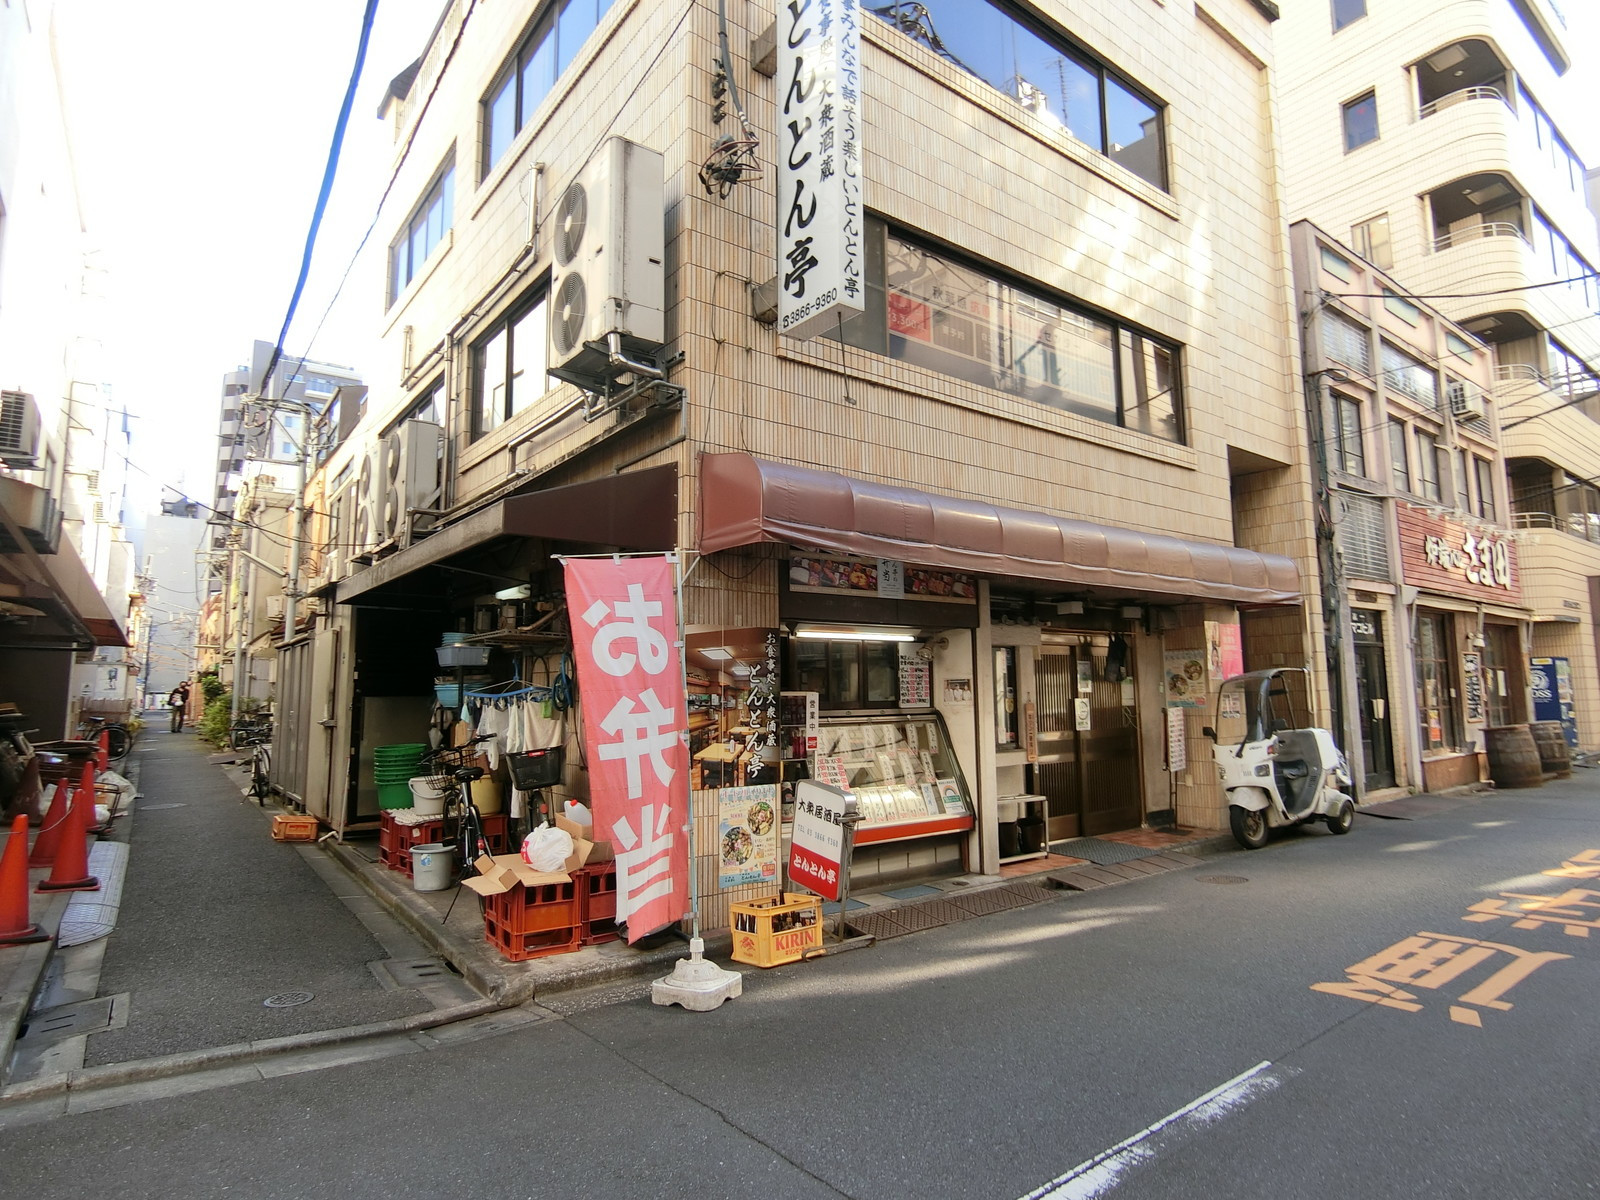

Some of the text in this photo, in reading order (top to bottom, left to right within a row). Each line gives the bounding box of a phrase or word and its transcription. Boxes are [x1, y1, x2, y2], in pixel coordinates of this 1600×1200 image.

[746, 664, 765, 778] とんとん亭
[808, 699, 816, 732] 営業中
[793, 852, 836, 885] とんとん亭
[775, 929, 814, 951] KIRIN
